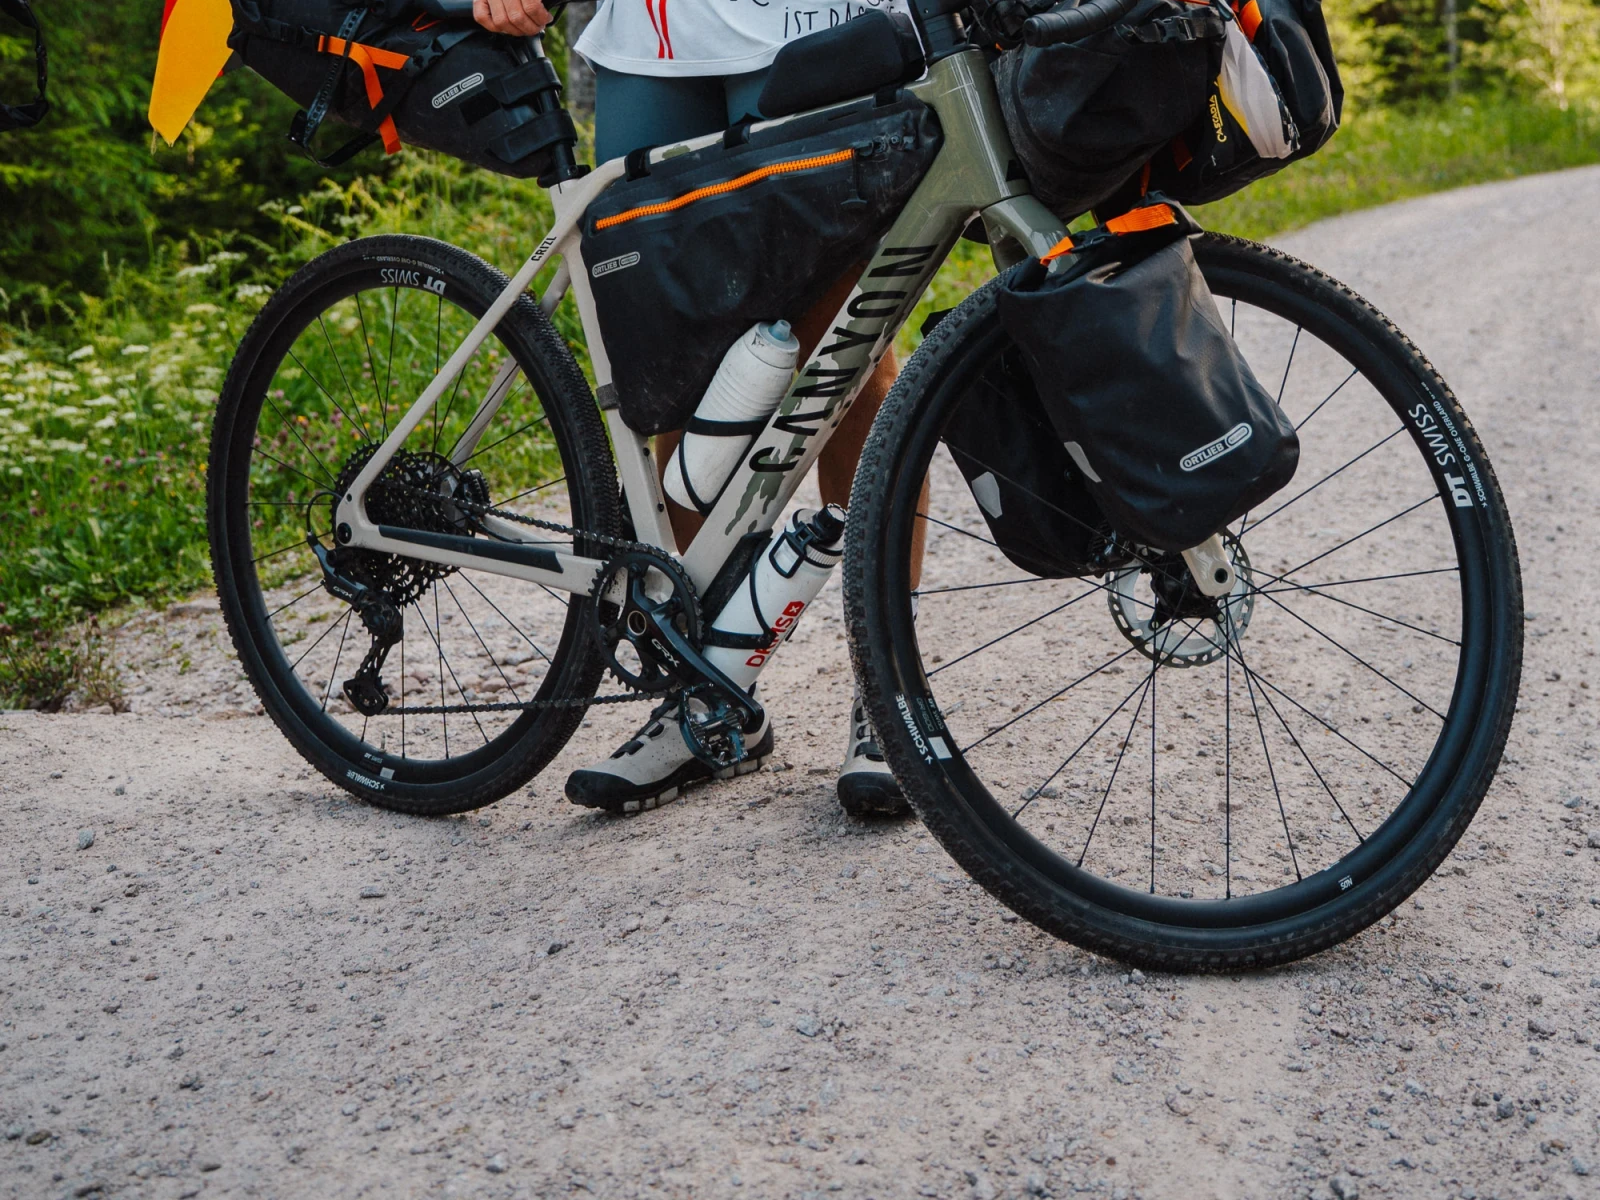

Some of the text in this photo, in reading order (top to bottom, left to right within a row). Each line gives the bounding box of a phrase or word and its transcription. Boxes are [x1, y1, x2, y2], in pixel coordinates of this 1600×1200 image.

[434, 86, 460, 106] ORTLIEB
[1208, 94, 1227, 143] CASCADIA
[380, 268, 446, 295] DT SWISS
[593, 260, 618, 275] ORTLIEB
[748, 243, 940, 473] CANYON
[1183, 443, 1225, 468] ORTLIEB
[1408, 403, 1474, 508] DT SWISS
[1433, 400, 1487, 502] SCHWALBE G-ONE OVERLAND
[651, 638, 680, 668] GRX
[895, 693, 929, 755] SCHWALBE
[346, 769, 380, 790] SCHWALBE
